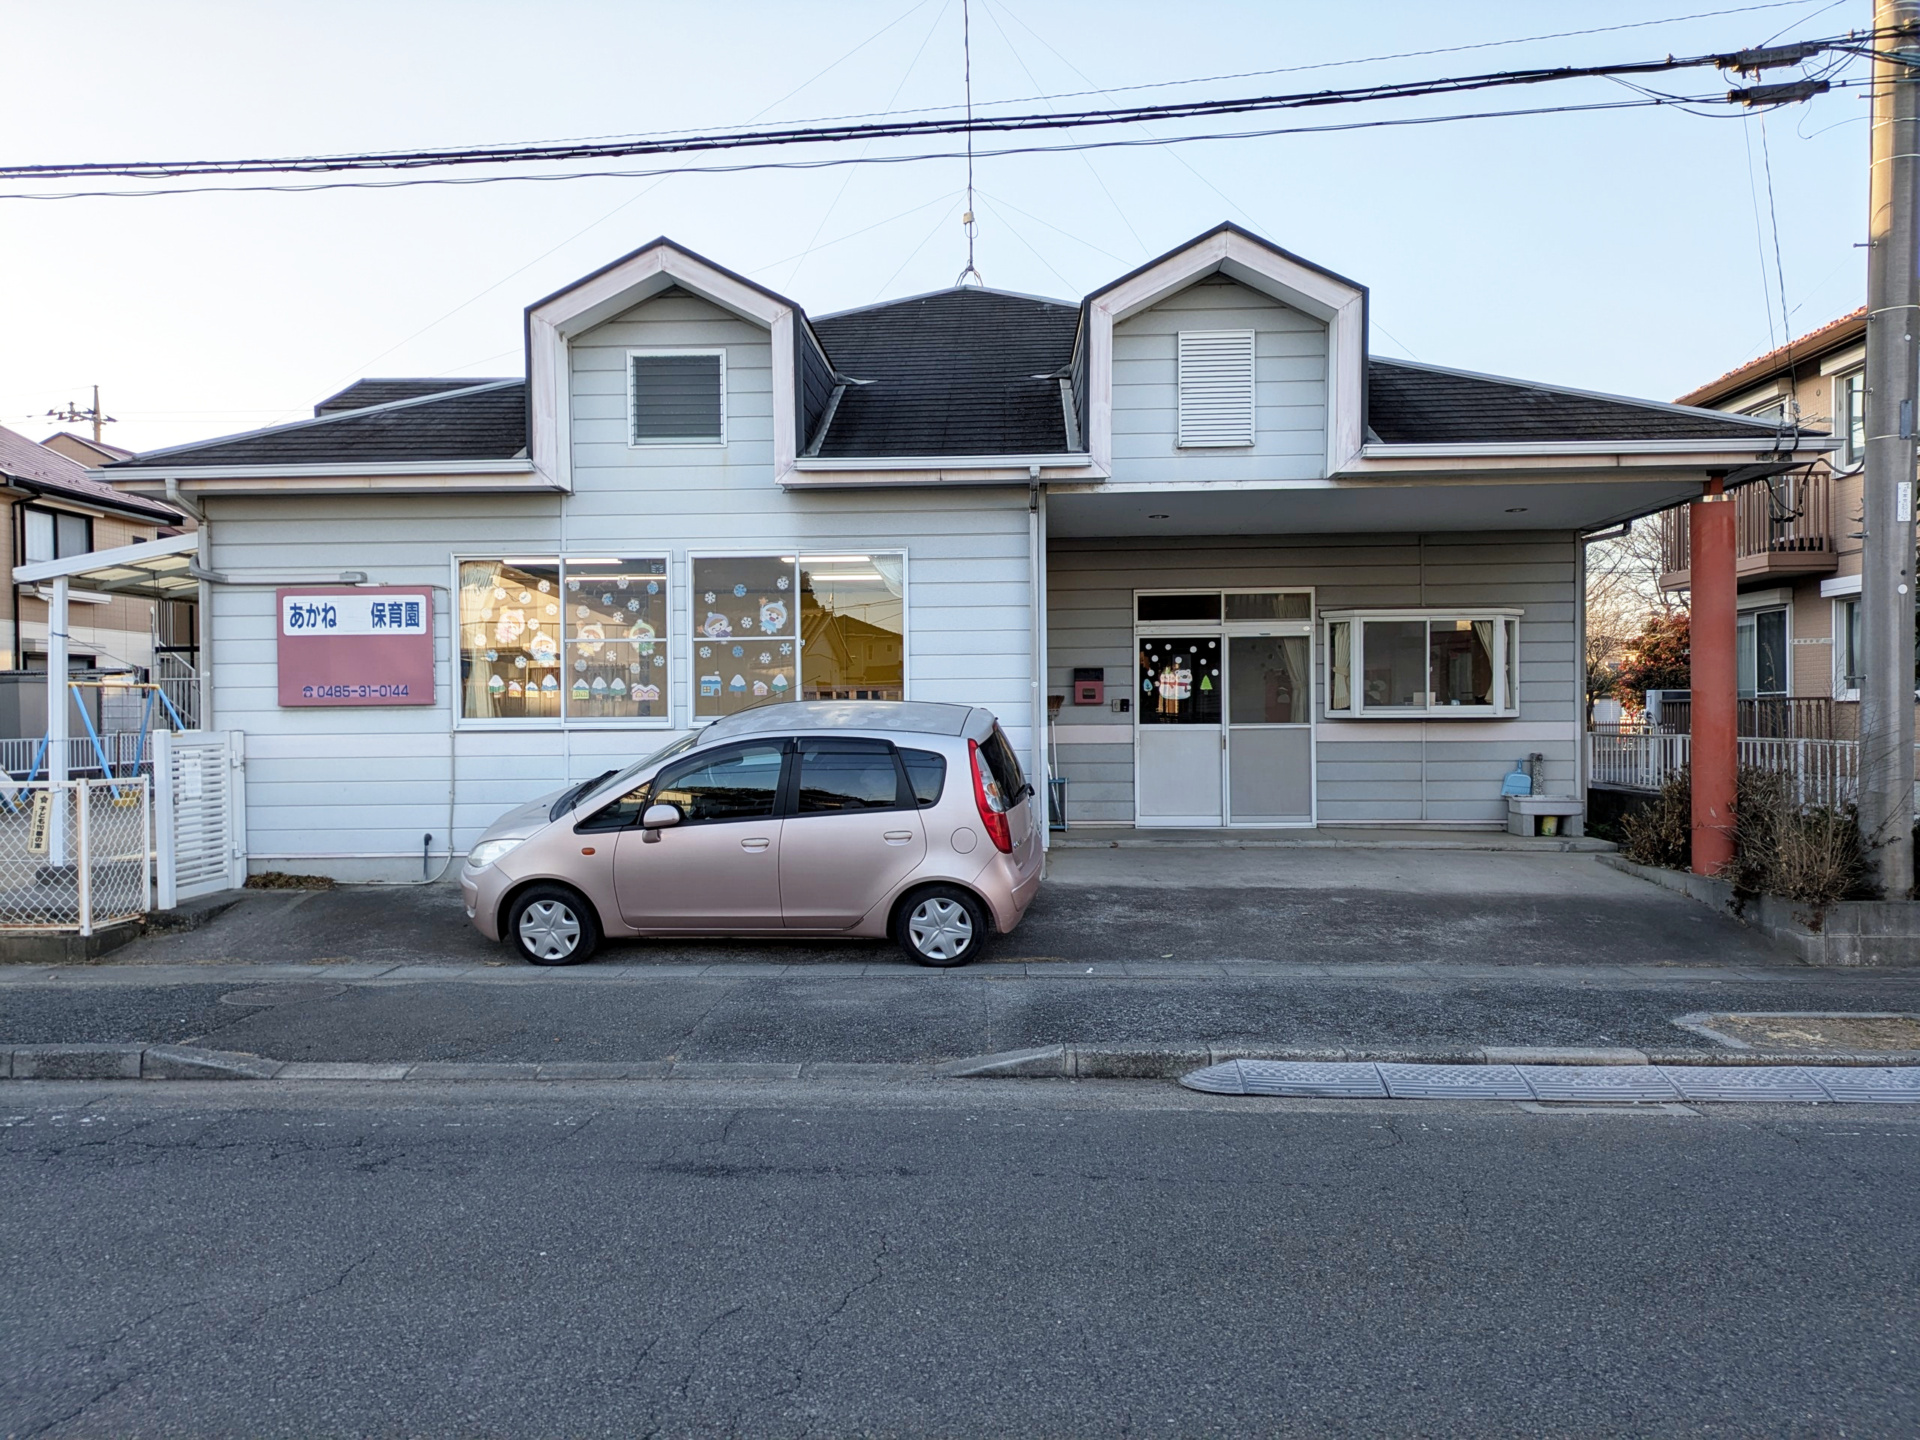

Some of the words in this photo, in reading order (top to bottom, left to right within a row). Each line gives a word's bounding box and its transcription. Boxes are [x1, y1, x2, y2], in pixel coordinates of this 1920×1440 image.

[289, 602, 337, 629] あかね
[371, 601, 420, 628] 保育園
[317, 685, 409, 697] 0485-31-0144
